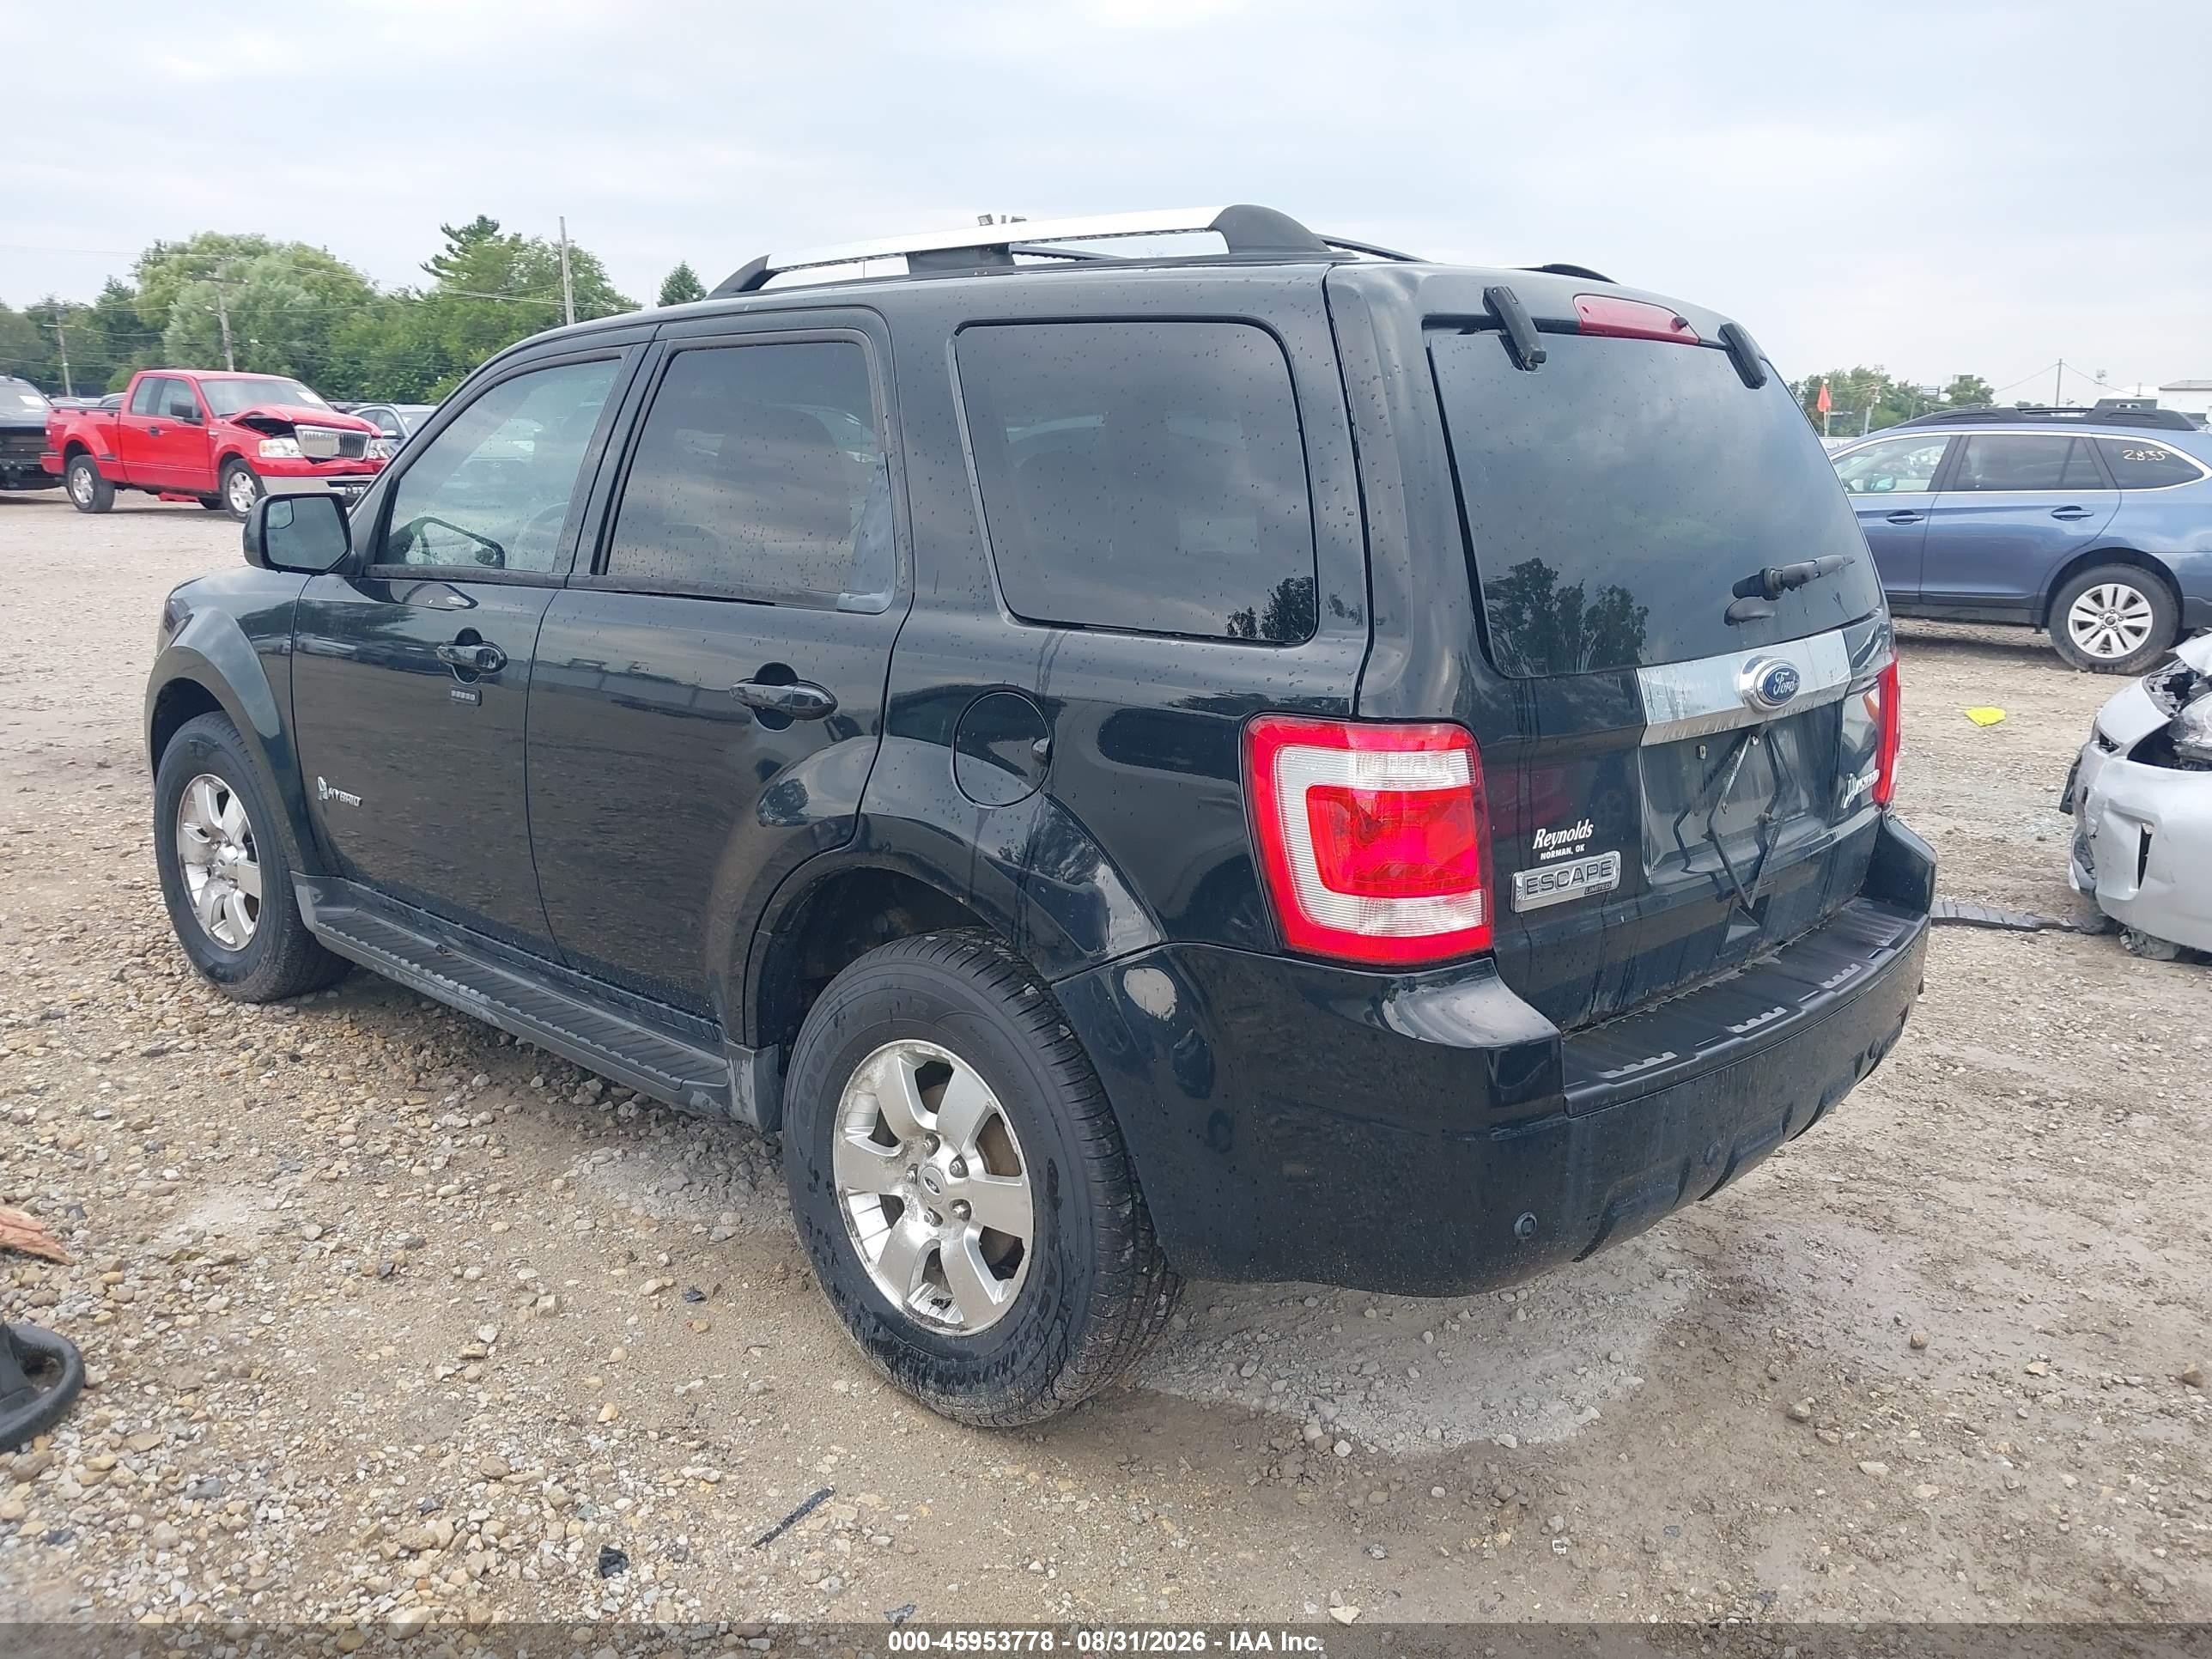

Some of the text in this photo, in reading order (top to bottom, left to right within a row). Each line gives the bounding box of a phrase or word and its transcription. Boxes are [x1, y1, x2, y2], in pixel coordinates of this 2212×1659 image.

[2122, 449, 2170, 461] 2835
[1773, 672, 1796, 696] Ford
[1533, 818, 1594, 850] Reynolds
[1540, 843, 1585, 860] NORMAN, OK
[1525, 860, 1613, 896] ESCAPE
[1585, 882, 1612, 894] LIMITED
